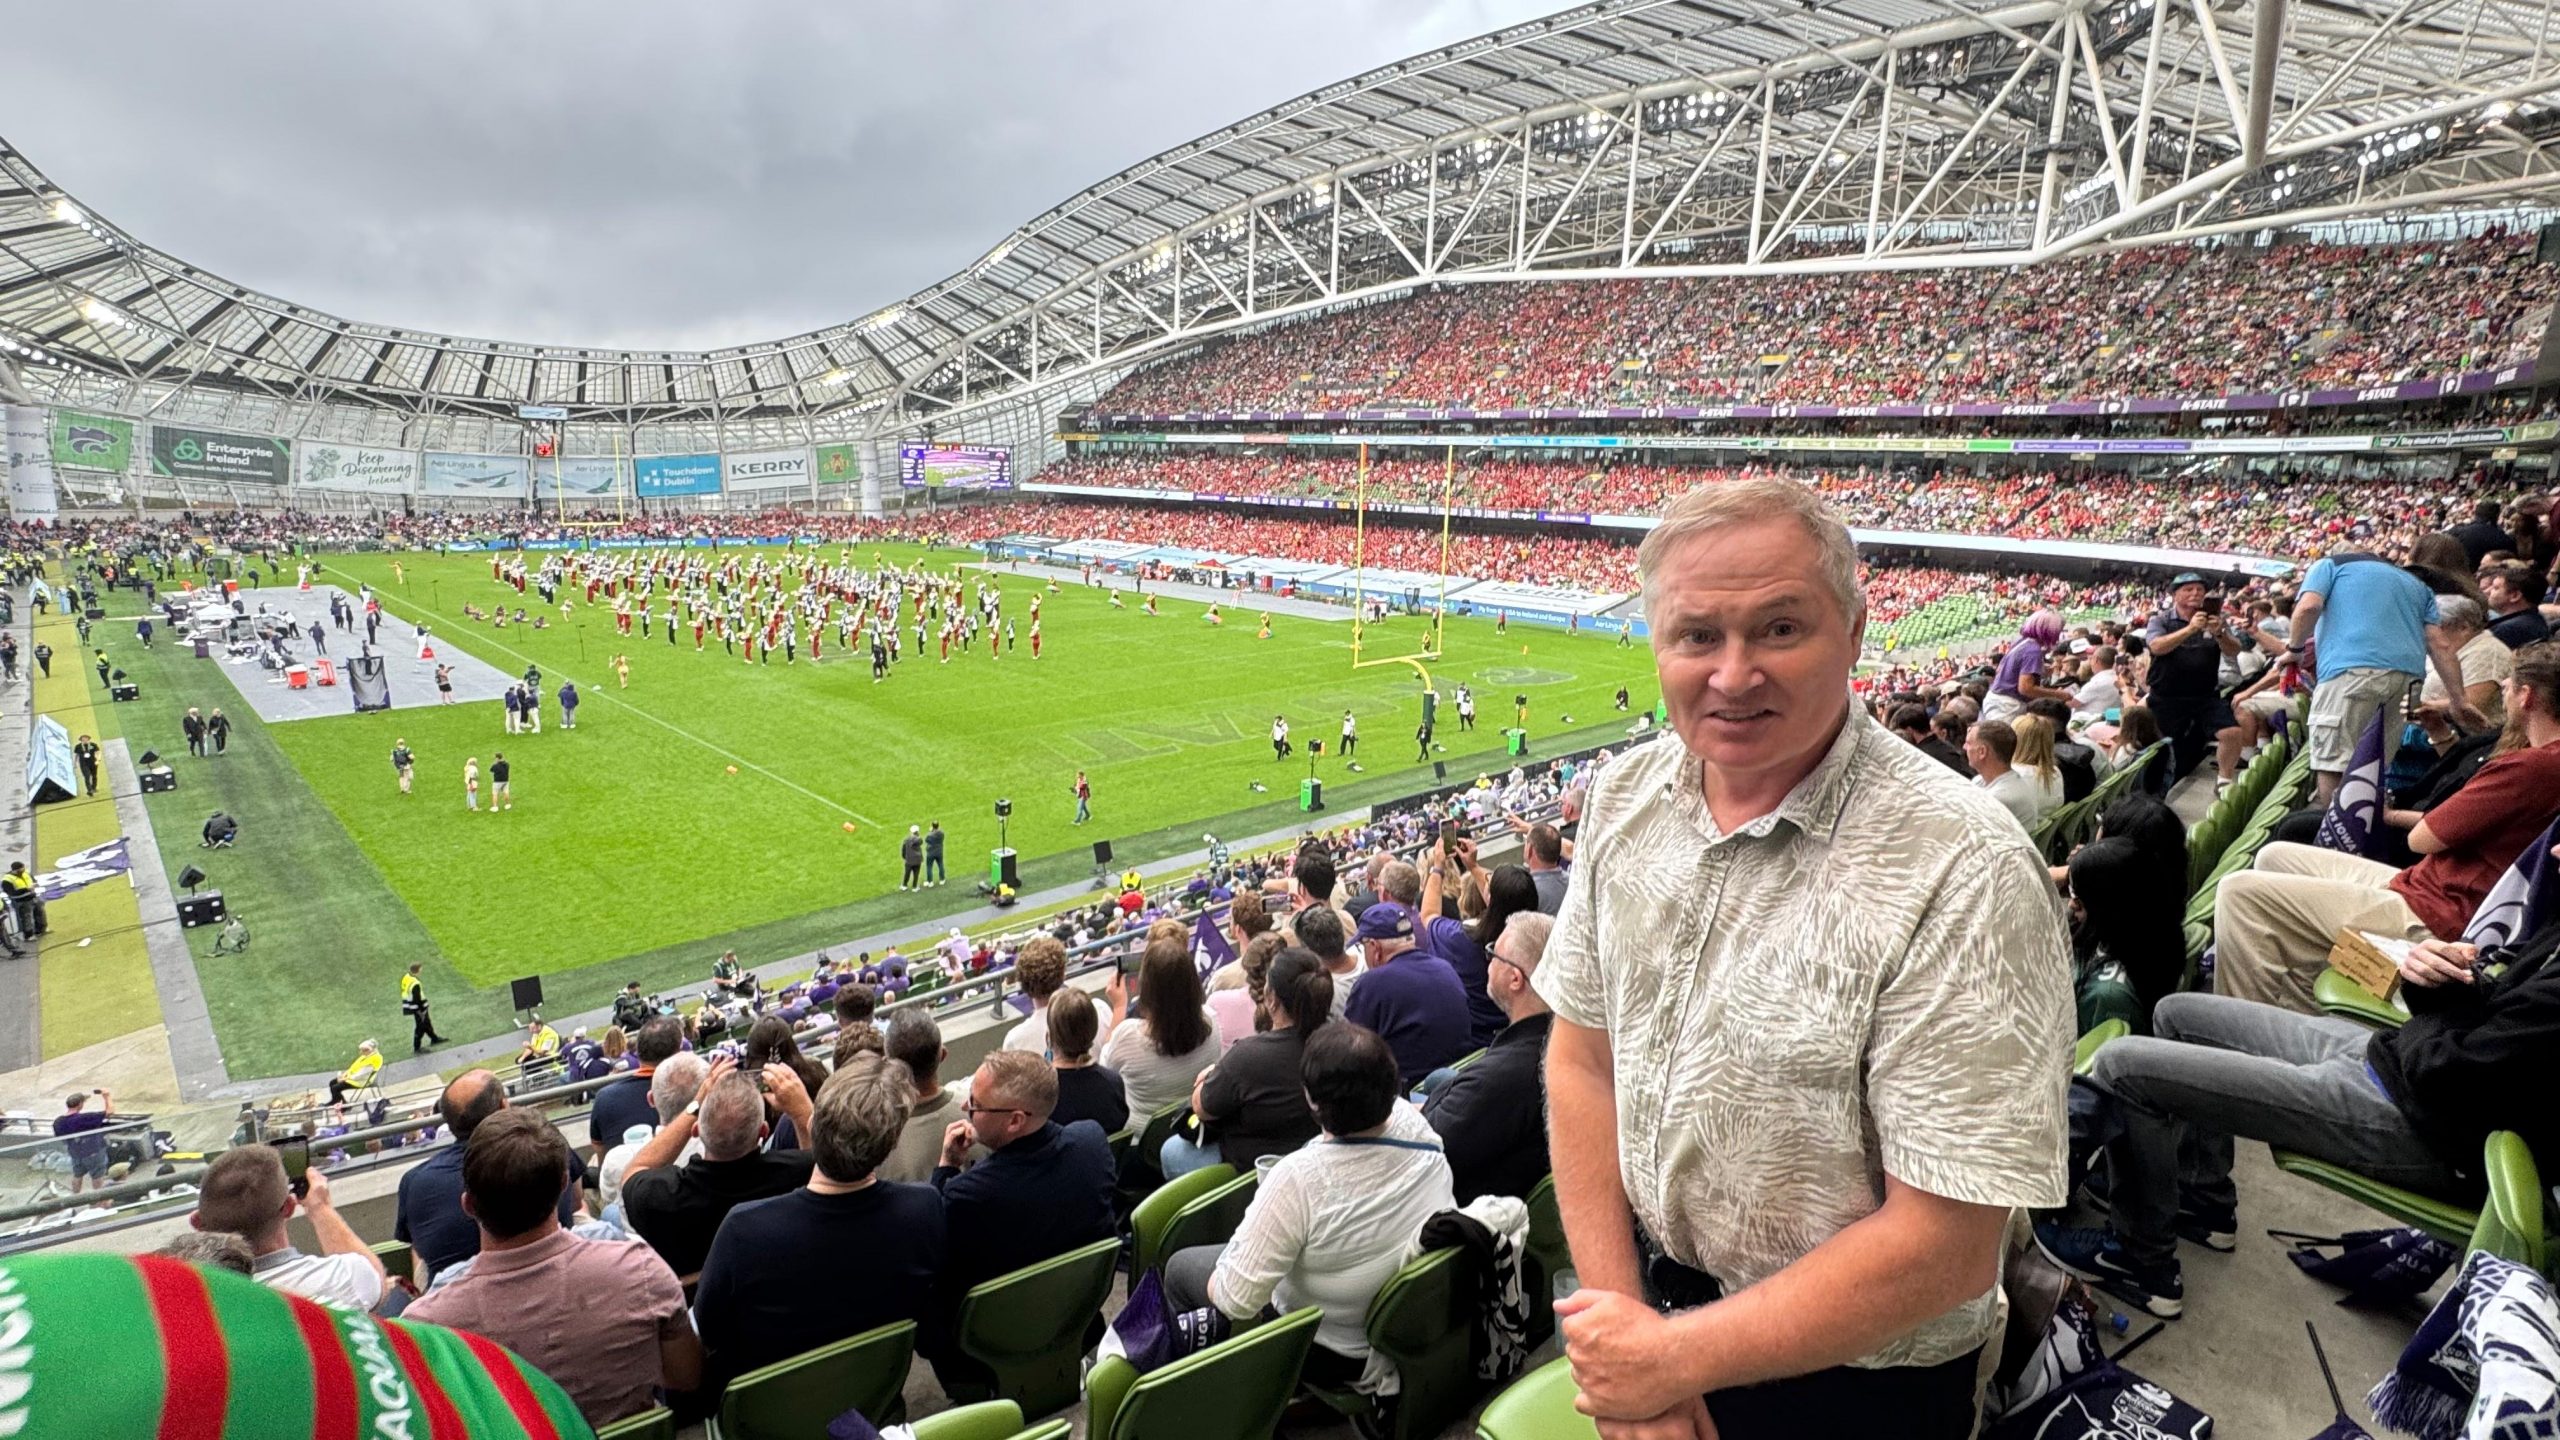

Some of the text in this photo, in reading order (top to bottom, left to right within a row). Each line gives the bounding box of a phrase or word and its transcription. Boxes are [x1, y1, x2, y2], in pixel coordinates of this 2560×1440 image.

[2357, 386, 2398, 401] K-STATE
[2002, 405, 2048, 415] K-STATE
[2181, 399, 2227, 411] K-STATE
[206, 441, 273, 458] Enterprise
[206, 452, 250, 465] Ireland
[357, 450, 385, 466] Keep
[341, 463, 412, 479] Discovering
[431, 460, 475, 470] Aer Lingus
[589, 466, 614, 474] Lingus
[663, 466, 715, 477] Touchdown
[731, 458, 805, 475] KERRY
[368, 474, 403, 486] Ireland
[664, 476, 695, 487] Dublin
[1492, 586, 1597, 600] KERRY
[1522, 610, 1538, 619] Ireland
[1549, 613, 1566, 623] Europe
[2334, 822, 2357, 852] IOWA
